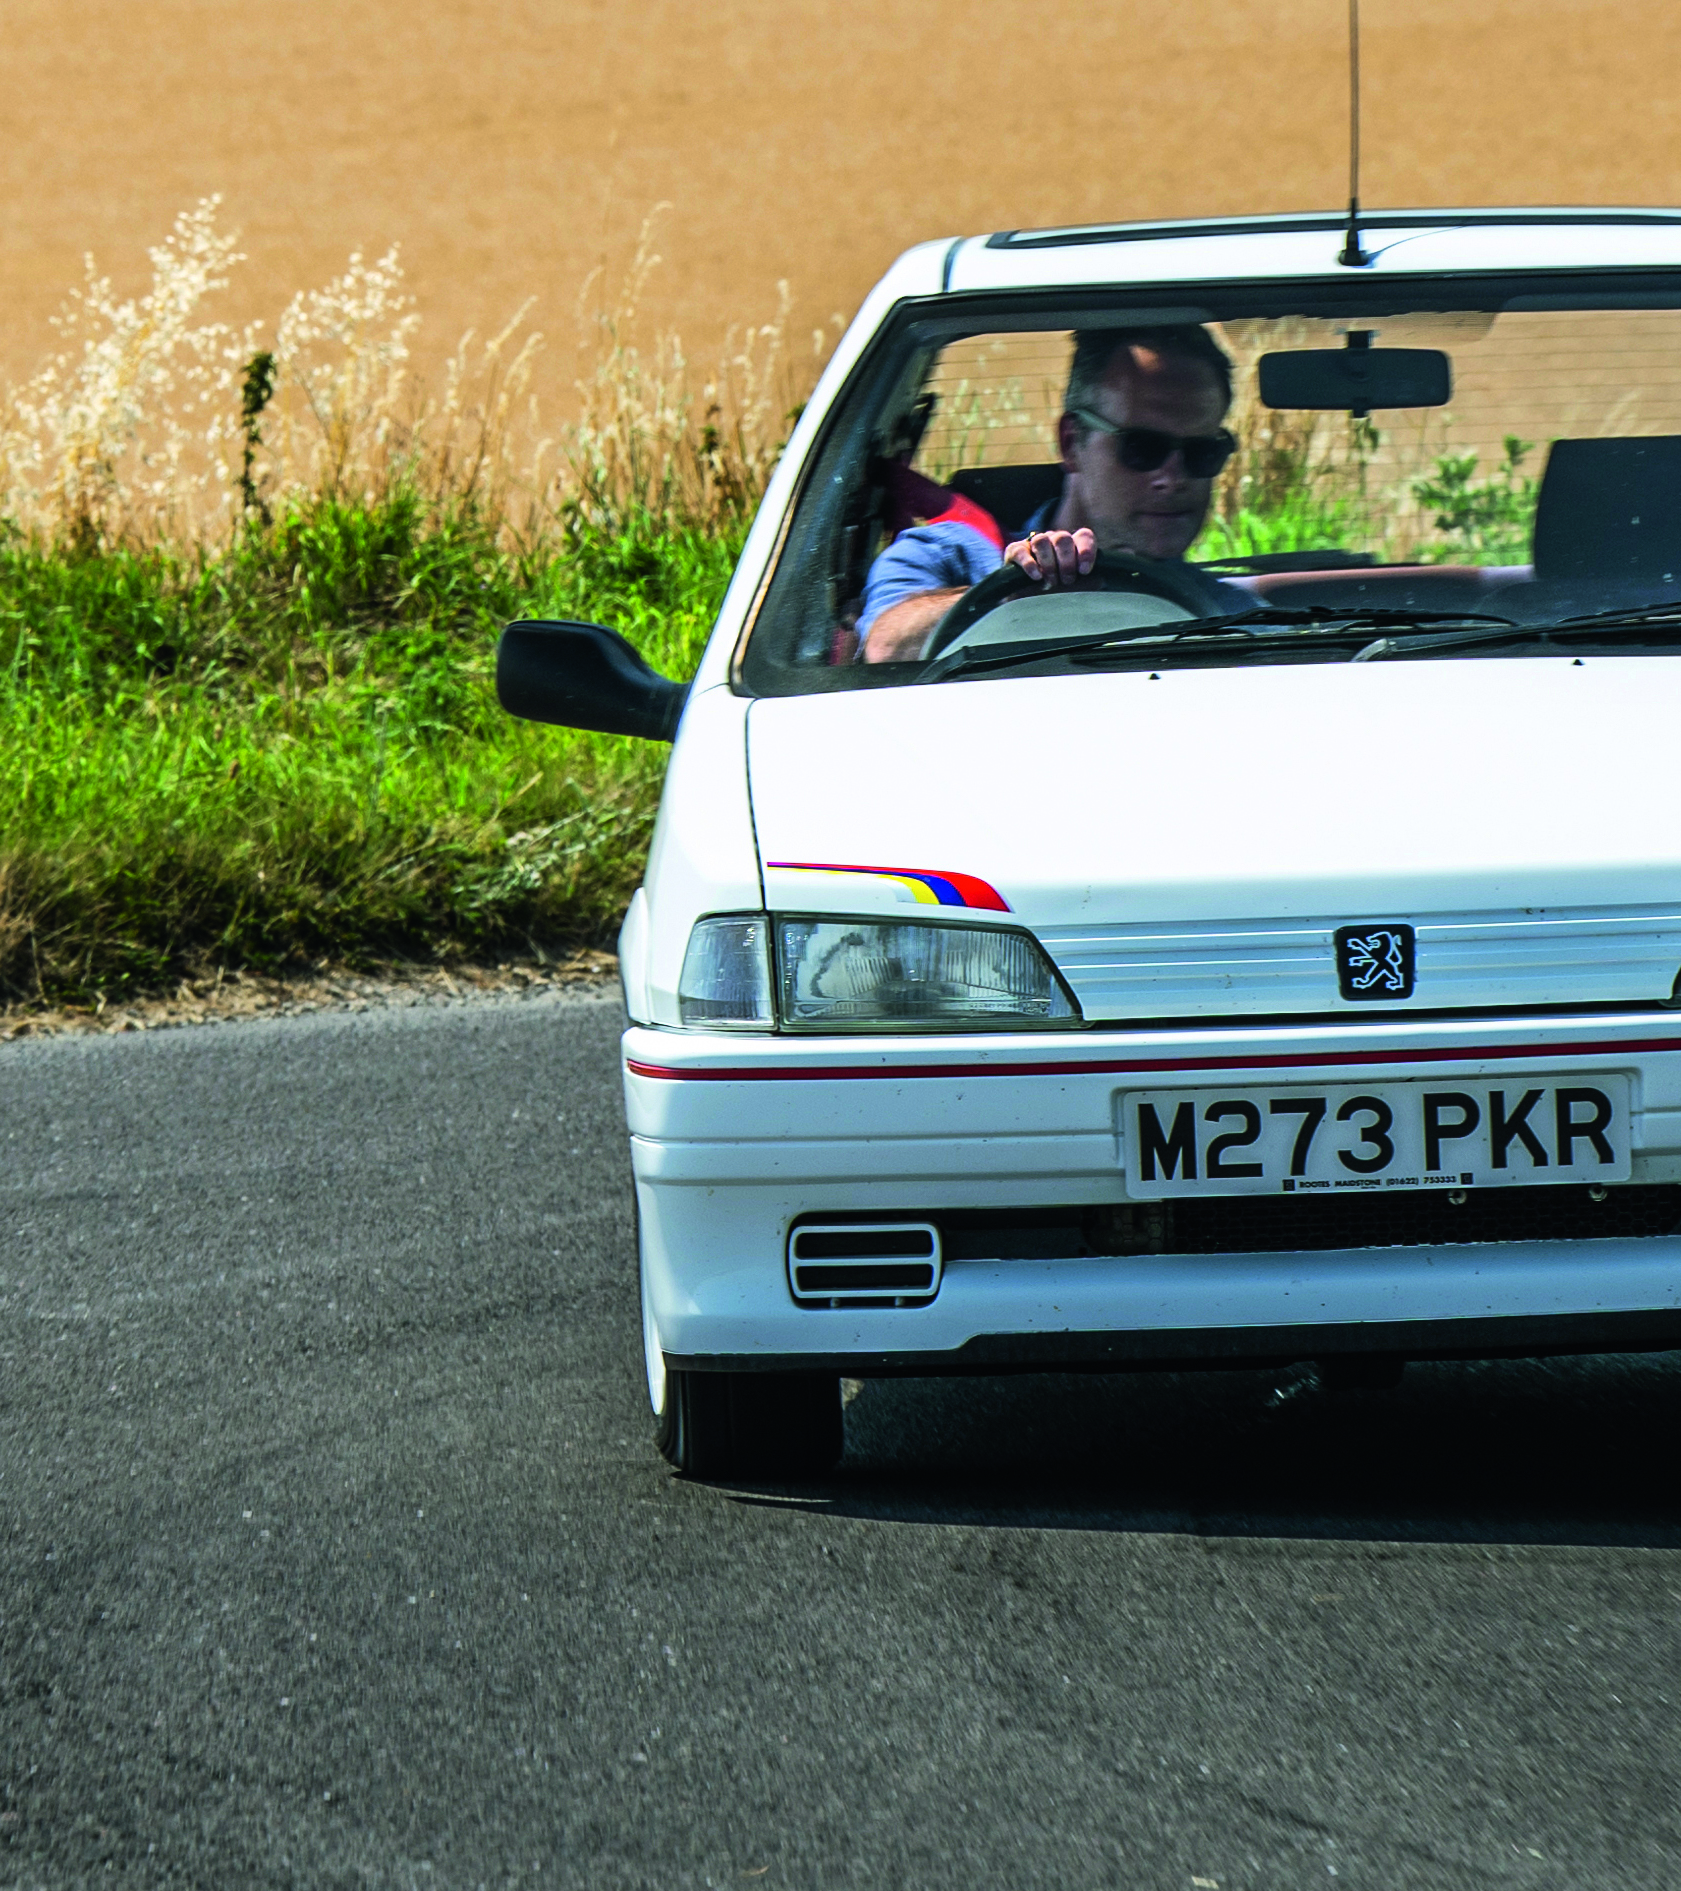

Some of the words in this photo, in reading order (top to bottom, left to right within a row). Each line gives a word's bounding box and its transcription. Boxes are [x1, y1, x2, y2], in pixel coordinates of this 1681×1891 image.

[1137, 1095, 1395, 1182] M273
[1423, 1087, 1615, 1171] PKR
[1299, 1180, 1330, 1188] ROOTES
[1335, 1178, 1381, 1187] MAIDSTONE
[1386, 1177, 1419, 1186] (01622)
